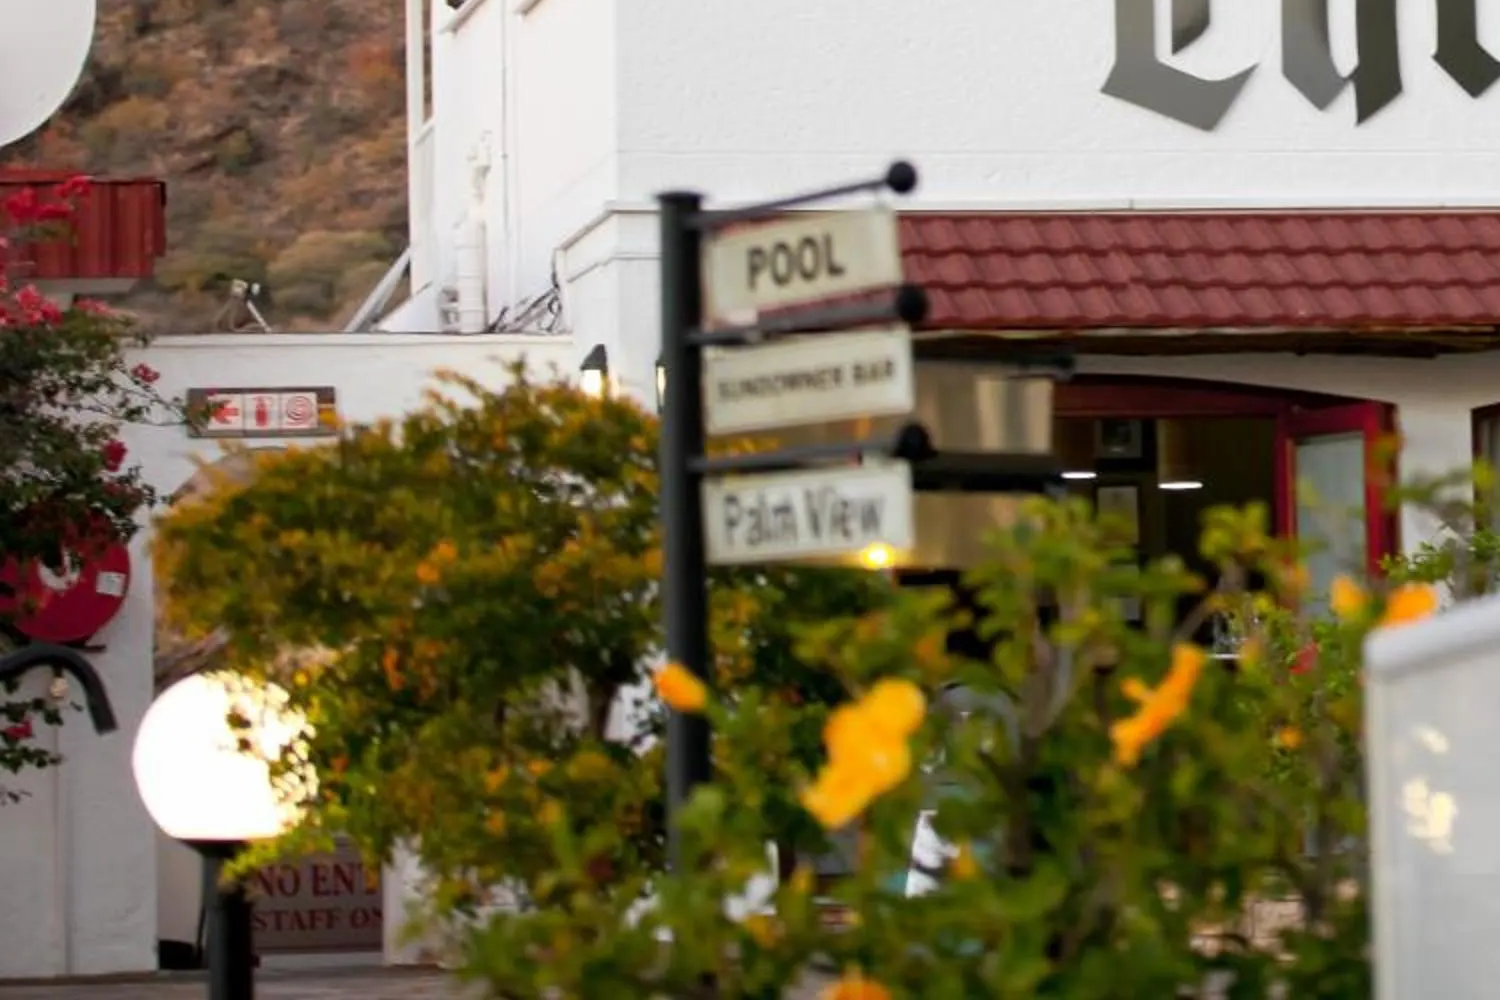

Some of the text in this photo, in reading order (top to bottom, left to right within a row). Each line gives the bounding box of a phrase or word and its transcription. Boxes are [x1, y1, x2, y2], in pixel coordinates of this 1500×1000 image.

[746, 232, 846, 290] POOL
[722, 485, 887, 547] Palm View
[251, 863, 301, 898] NO
[251, 907, 343, 933] STAFF
